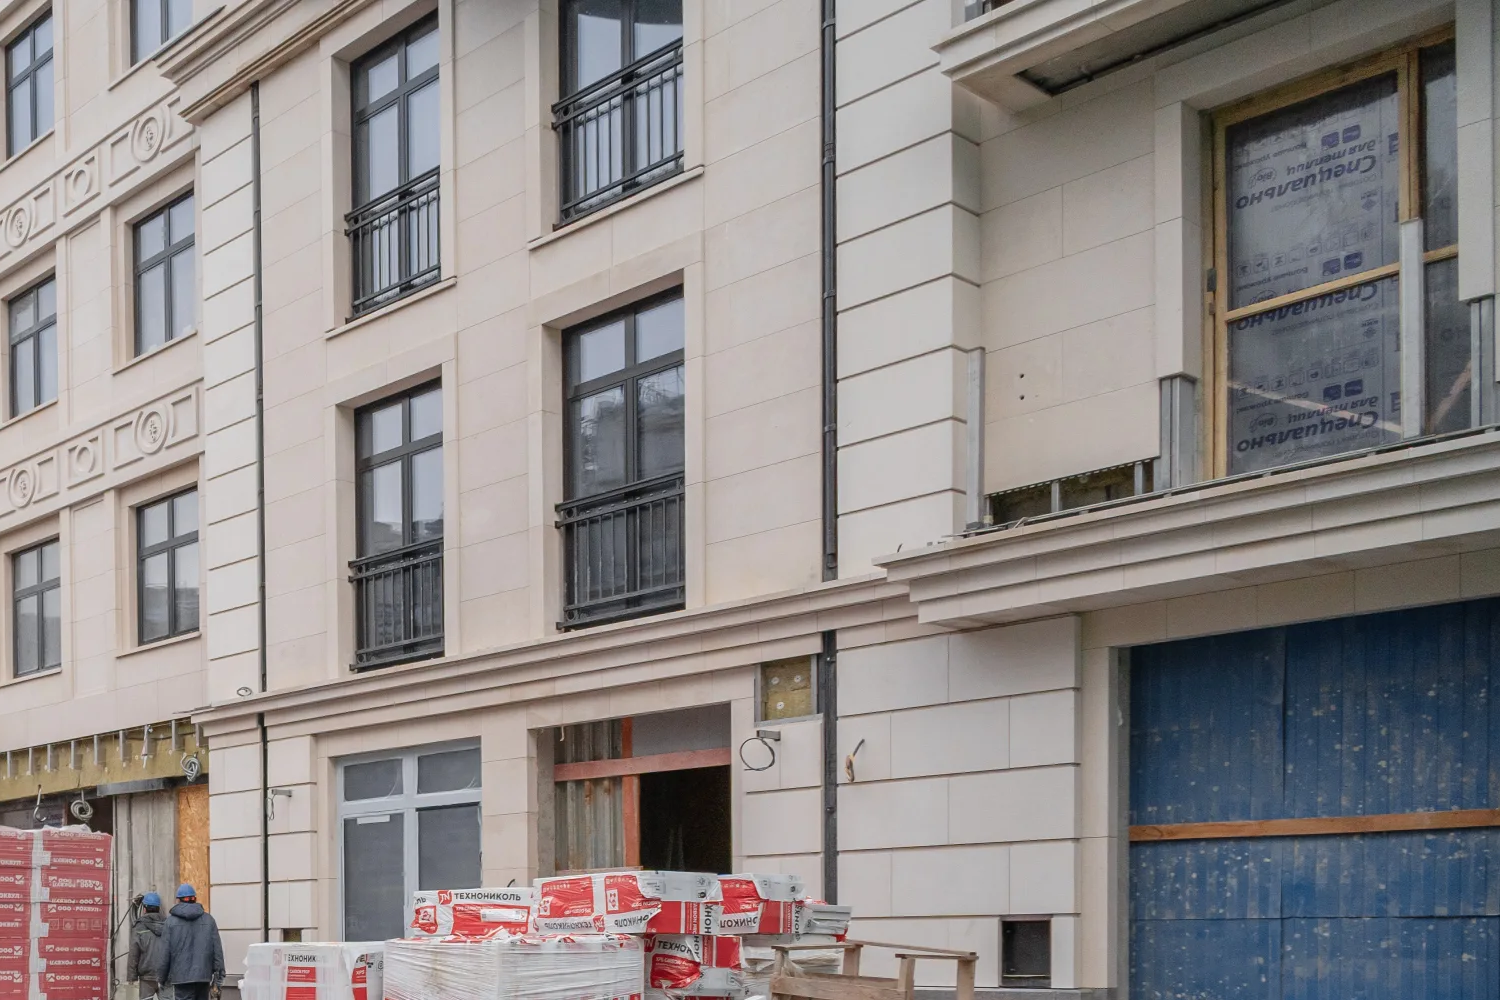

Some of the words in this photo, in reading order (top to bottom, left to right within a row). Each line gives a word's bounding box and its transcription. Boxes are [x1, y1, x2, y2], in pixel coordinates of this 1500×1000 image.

[1348, 139, 1376, 156] для
[1287, 148, 1347, 176] теплиц
[1235, 154, 1377, 210] Специально
[1351, 396, 1378, 410] для
[1288, 402, 1349, 424] теплиц
[1237, 411, 1378, 452] Специально
[454, 892, 521, 901] ТЕХНОНИКОЛЬ
[544, 921, 593, 930] ТЕХНОНИКОЛЬ
